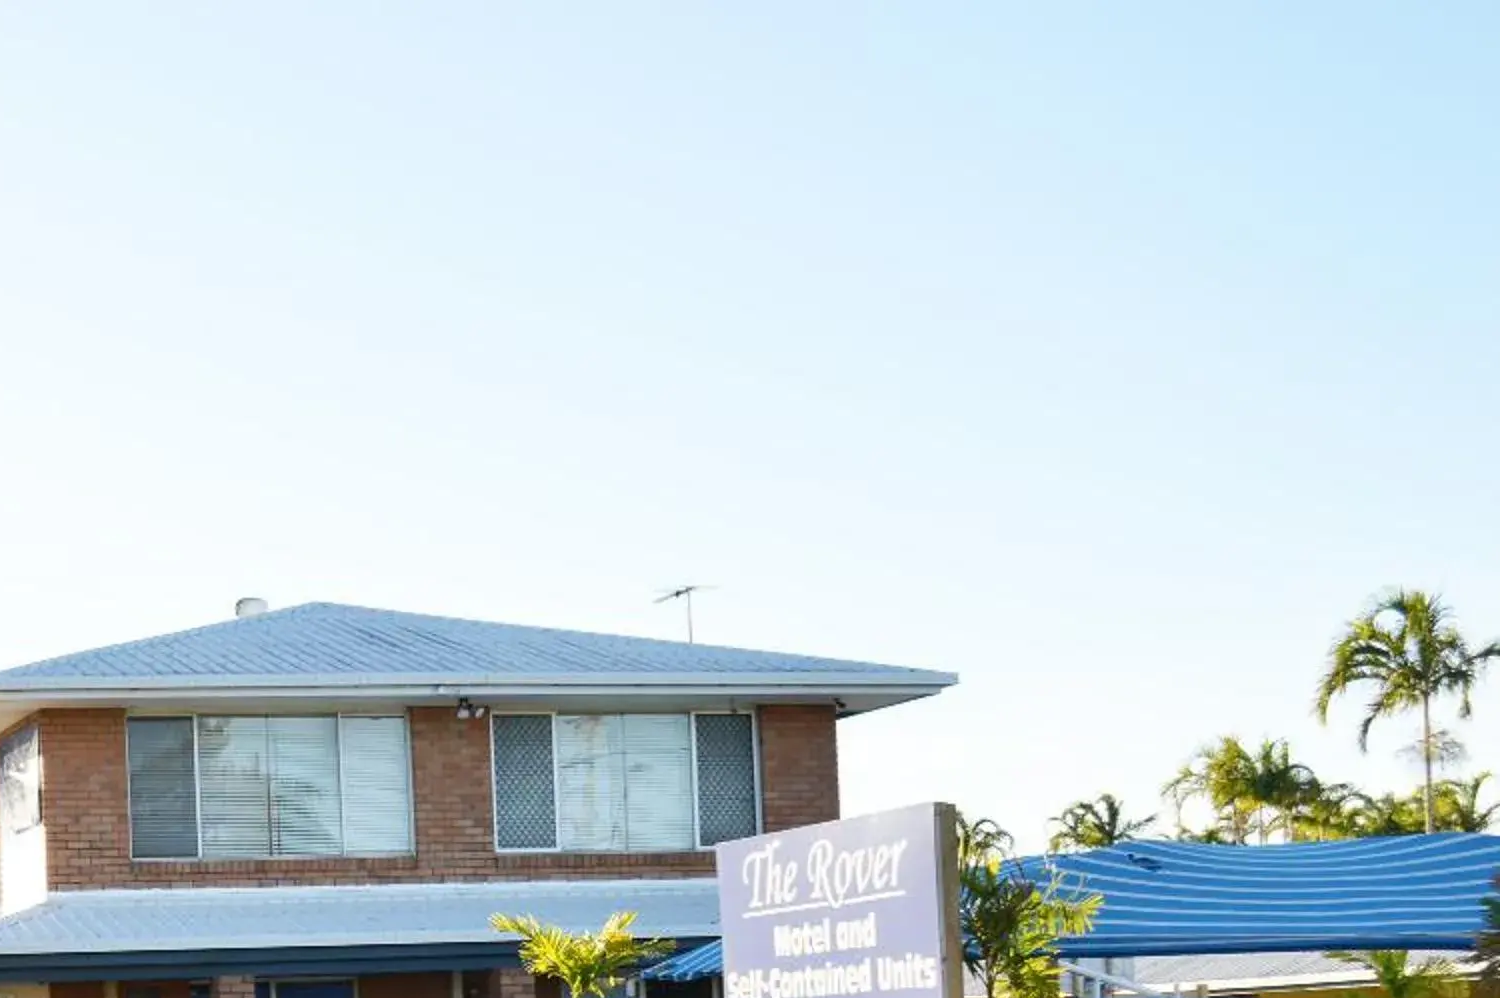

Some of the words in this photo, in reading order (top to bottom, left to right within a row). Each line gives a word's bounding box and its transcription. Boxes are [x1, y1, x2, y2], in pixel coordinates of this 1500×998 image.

[742, 838, 798, 908] The
[806, 838, 907, 908] Rover
[773, 917, 830, 956] Motel
[836, 911, 877, 948] and
[877, 952, 937, 990] Units
